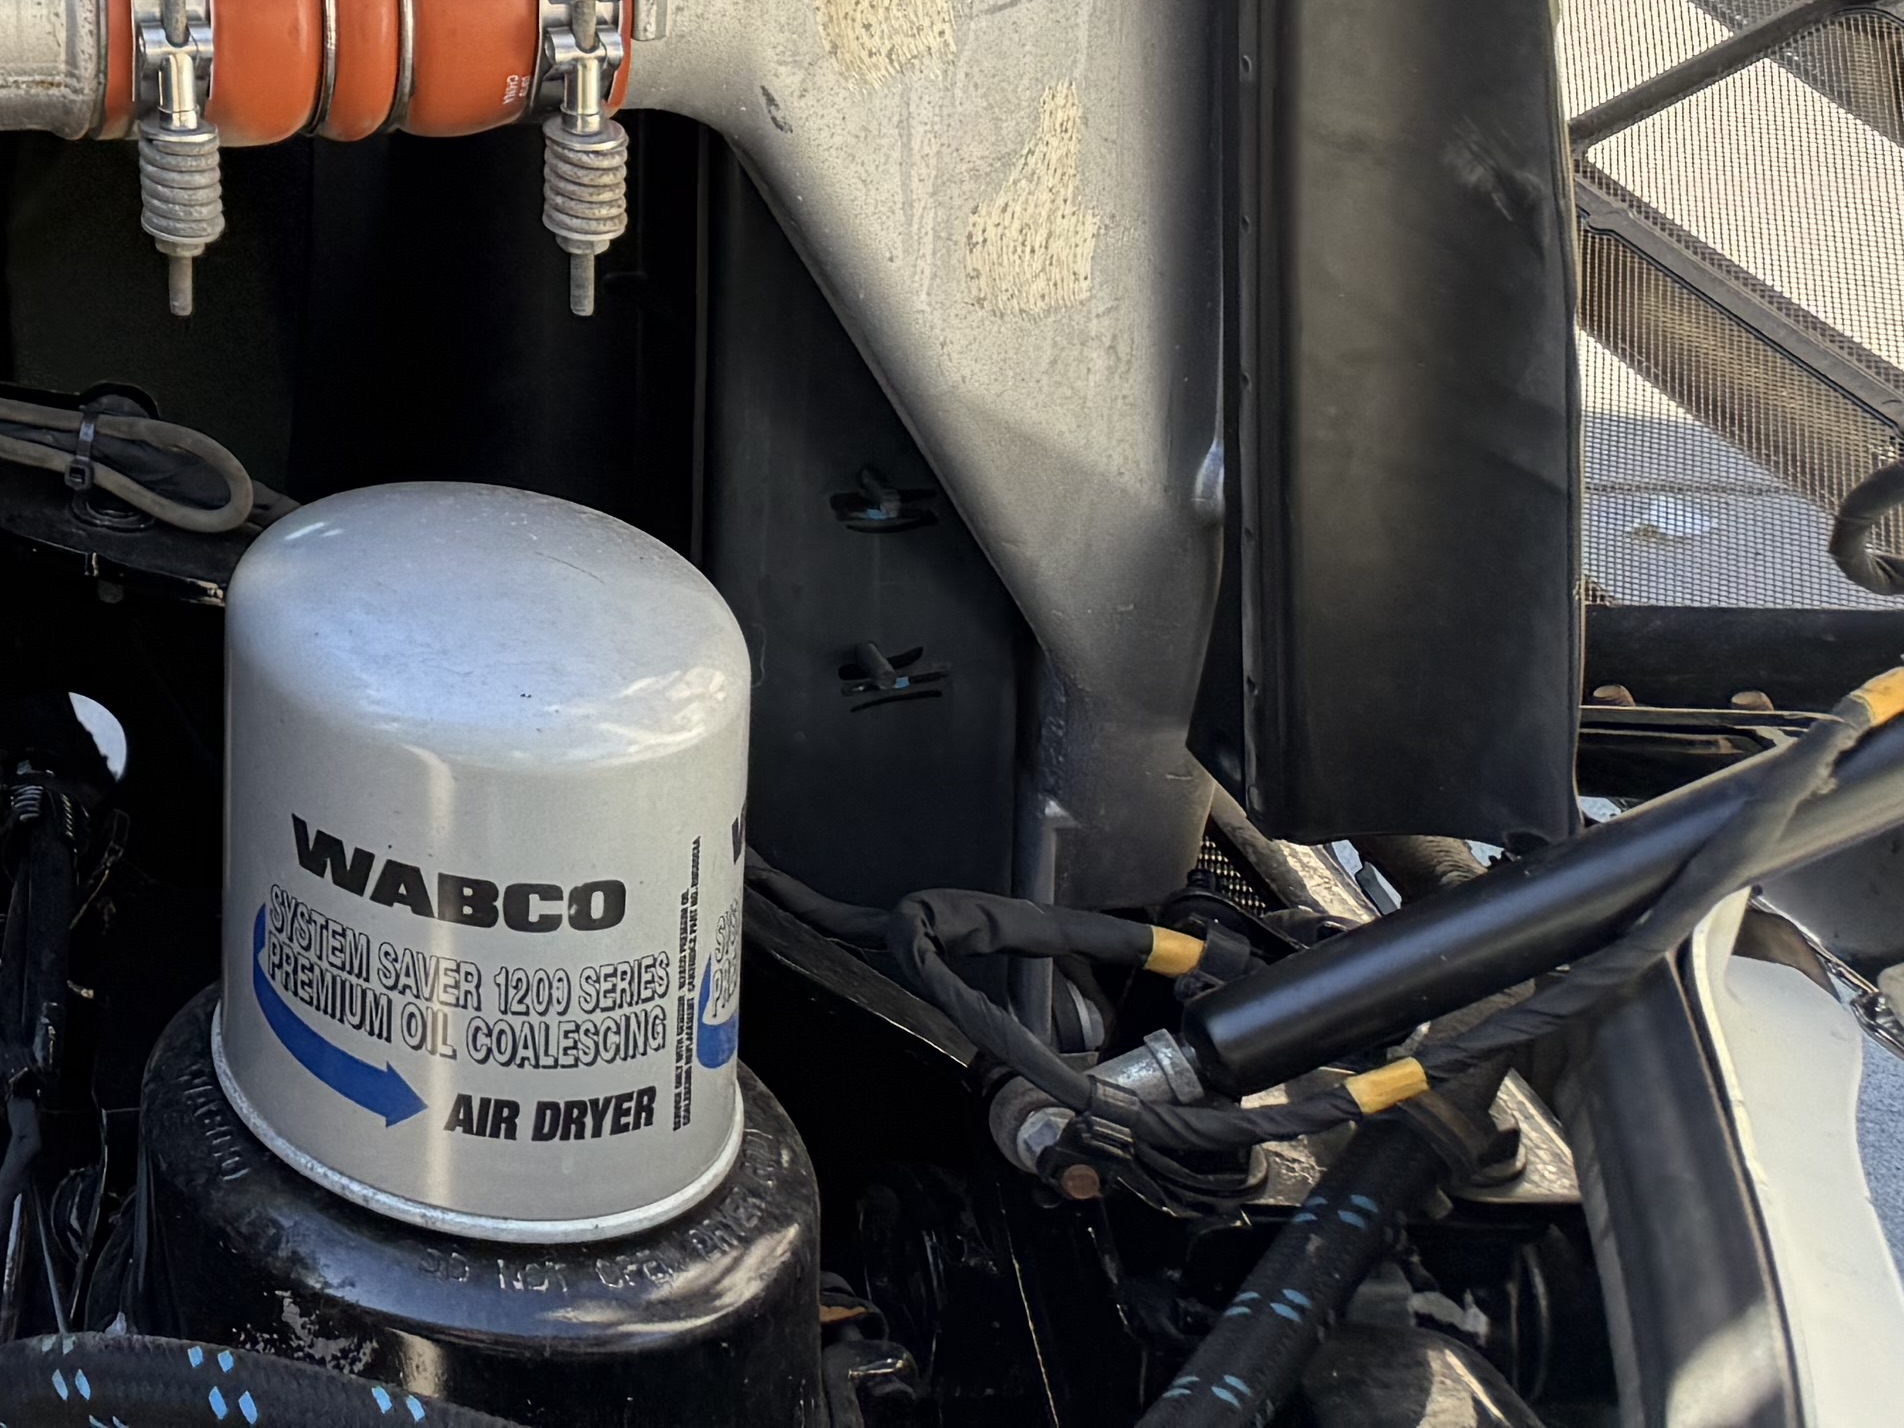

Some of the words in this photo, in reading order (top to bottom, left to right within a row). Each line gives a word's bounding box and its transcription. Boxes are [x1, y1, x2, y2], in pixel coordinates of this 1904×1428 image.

[292, 812, 627, 933] WABCO
[267, 930, 393, 1045] PREMIUM
[400, 1001, 457, 1060] OIL
[466, 1004, 668, 1070] COALESCING
[269, 883, 371, 983] SYSTEM
[378, 941, 482, 1012] SAVER
[494, 965, 572, 1017] 1200
[577, 950, 671, 1013] SERIES
[443, 1093, 521, 1142] AIR
[531, 1084, 657, 1143] DRYER
